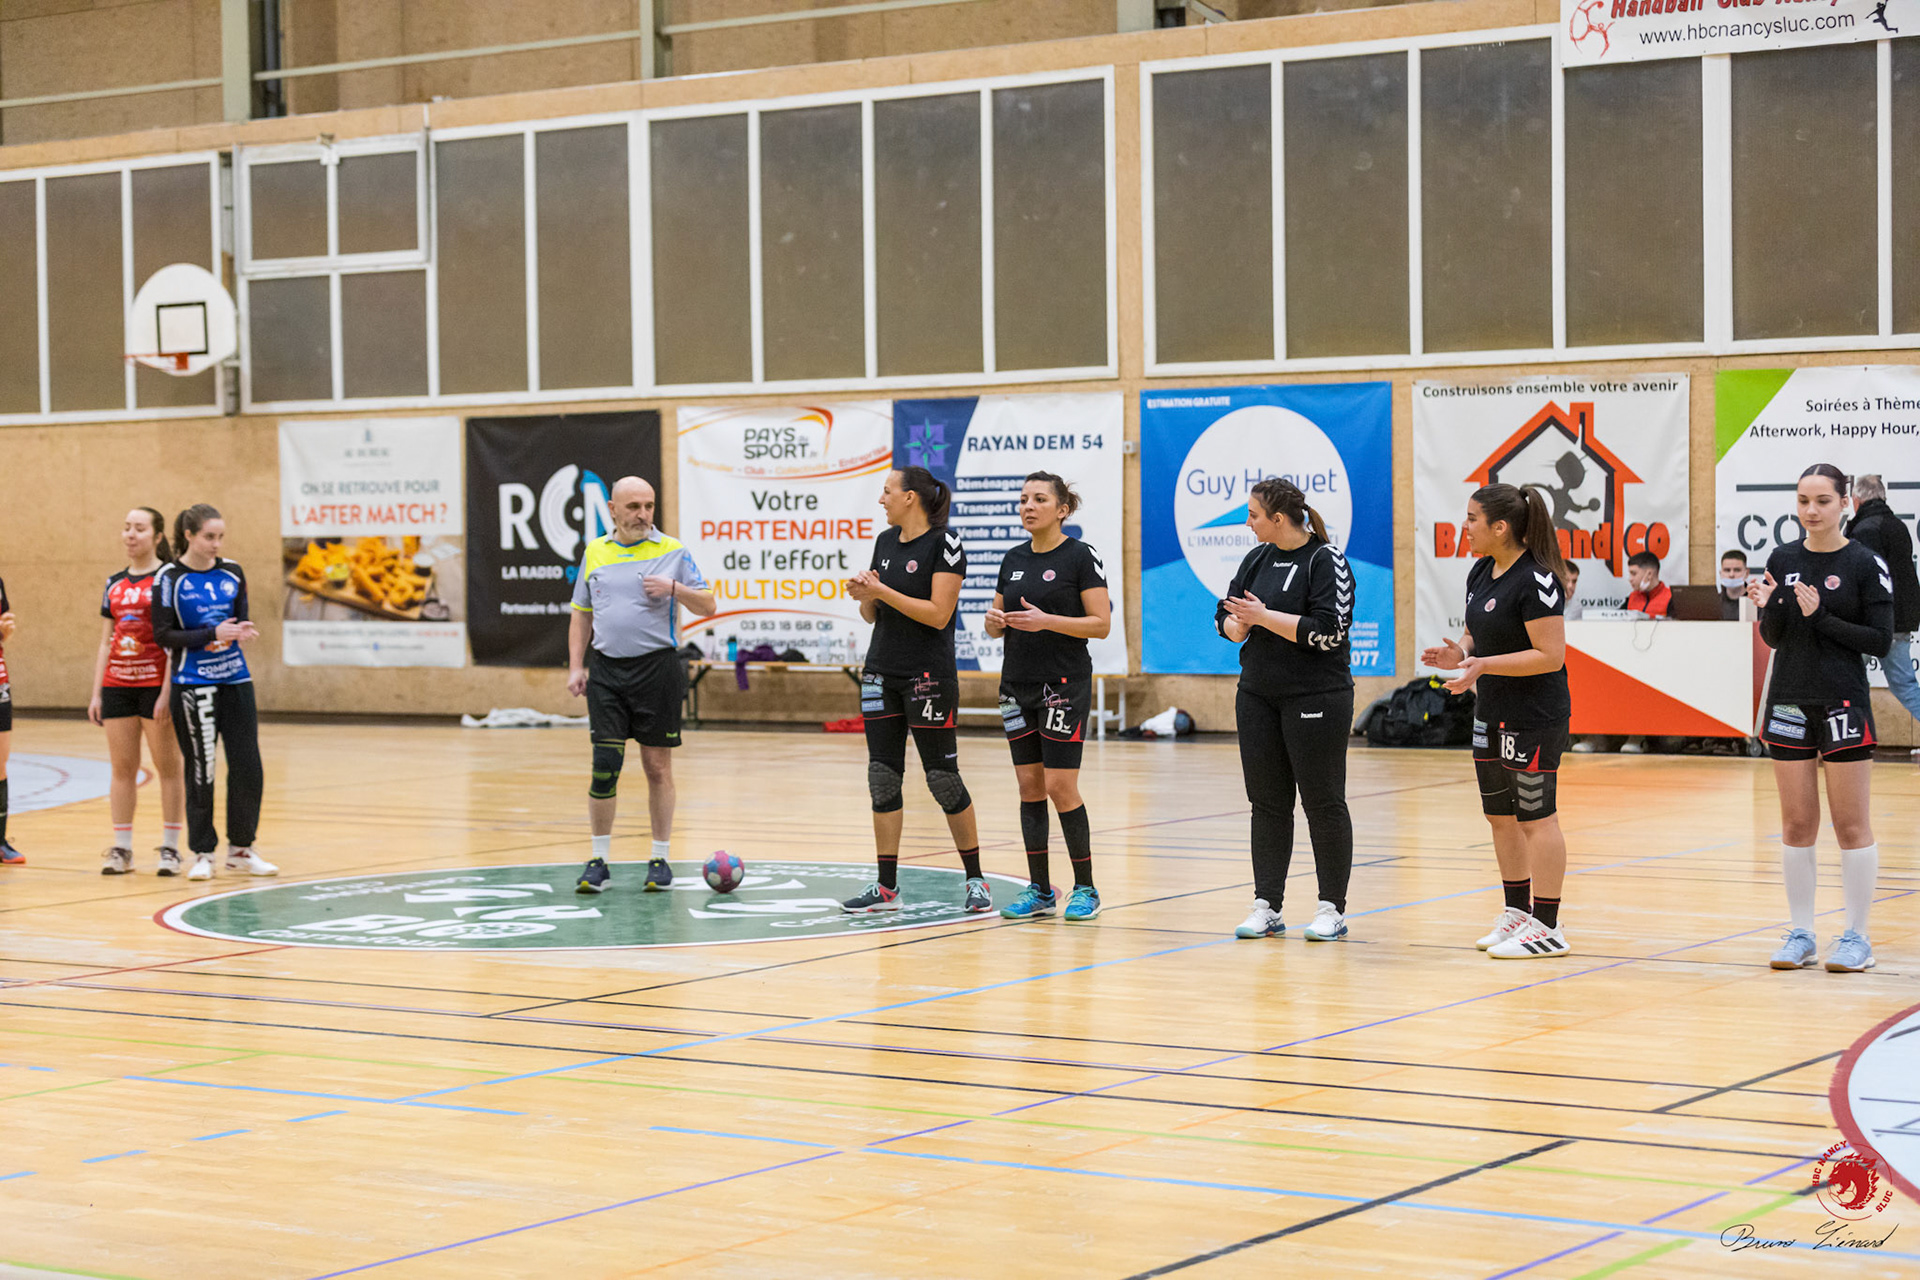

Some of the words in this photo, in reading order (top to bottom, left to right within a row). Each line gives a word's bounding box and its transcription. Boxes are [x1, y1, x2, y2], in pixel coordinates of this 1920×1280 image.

[1639, 12, 1855, 45] www.hbcnancysluc.com
[1423, 383, 1513, 398] Construisons
[1516, 381, 1585, 394] ensemble
[1589, 382, 1627, 393] votre
[1632, 379, 1679, 393] avenir
[1147, 398, 1193, 409] ESTIMATION
[1193, 396, 1230, 408] GRATUITE
[1805, 398, 1858, 412] Soirées
[1862, 397, 1871, 411] à
[744, 427, 796, 443] PAYS
[1749, 424, 1826, 438] Afterwork,
[1831, 423, 1877, 437] Happy
[1881, 422, 1919, 436] Hour,
[744, 443, 809, 459] SPORT
[967, 435, 1031, 451] RAYAN
[1034, 434, 1075, 450] DEM
[1082, 434, 1103, 449] 54
[338, 480, 401, 495] RETROUVE
[404, 479, 440, 493] POUR
[1186, 468, 1236, 500] Guy
[1244, 468, 1337, 493] Huet
[751, 490, 818, 511] Votre
[956, 502, 1012, 516] Transport
[291, 504, 362, 525] L'AFTER
[367, 503, 436, 524] MATCH
[701, 518, 874, 541] PARTENAIRE
[724, 550, 751, 571] de
[760, 549, 849, 571] l'effort
[881, 559, 890, 570] 4
[501, 566, 518, 579] LA
[519, 566, 564, 579] RADIO
[203, 581, 217, 601] 1
[922, 699, 933, 720] 4
[1045, 707, 1065, 732] 13
[1827, 713, 1848, 741] 17
[1501, 734, 1515, 760] 18
